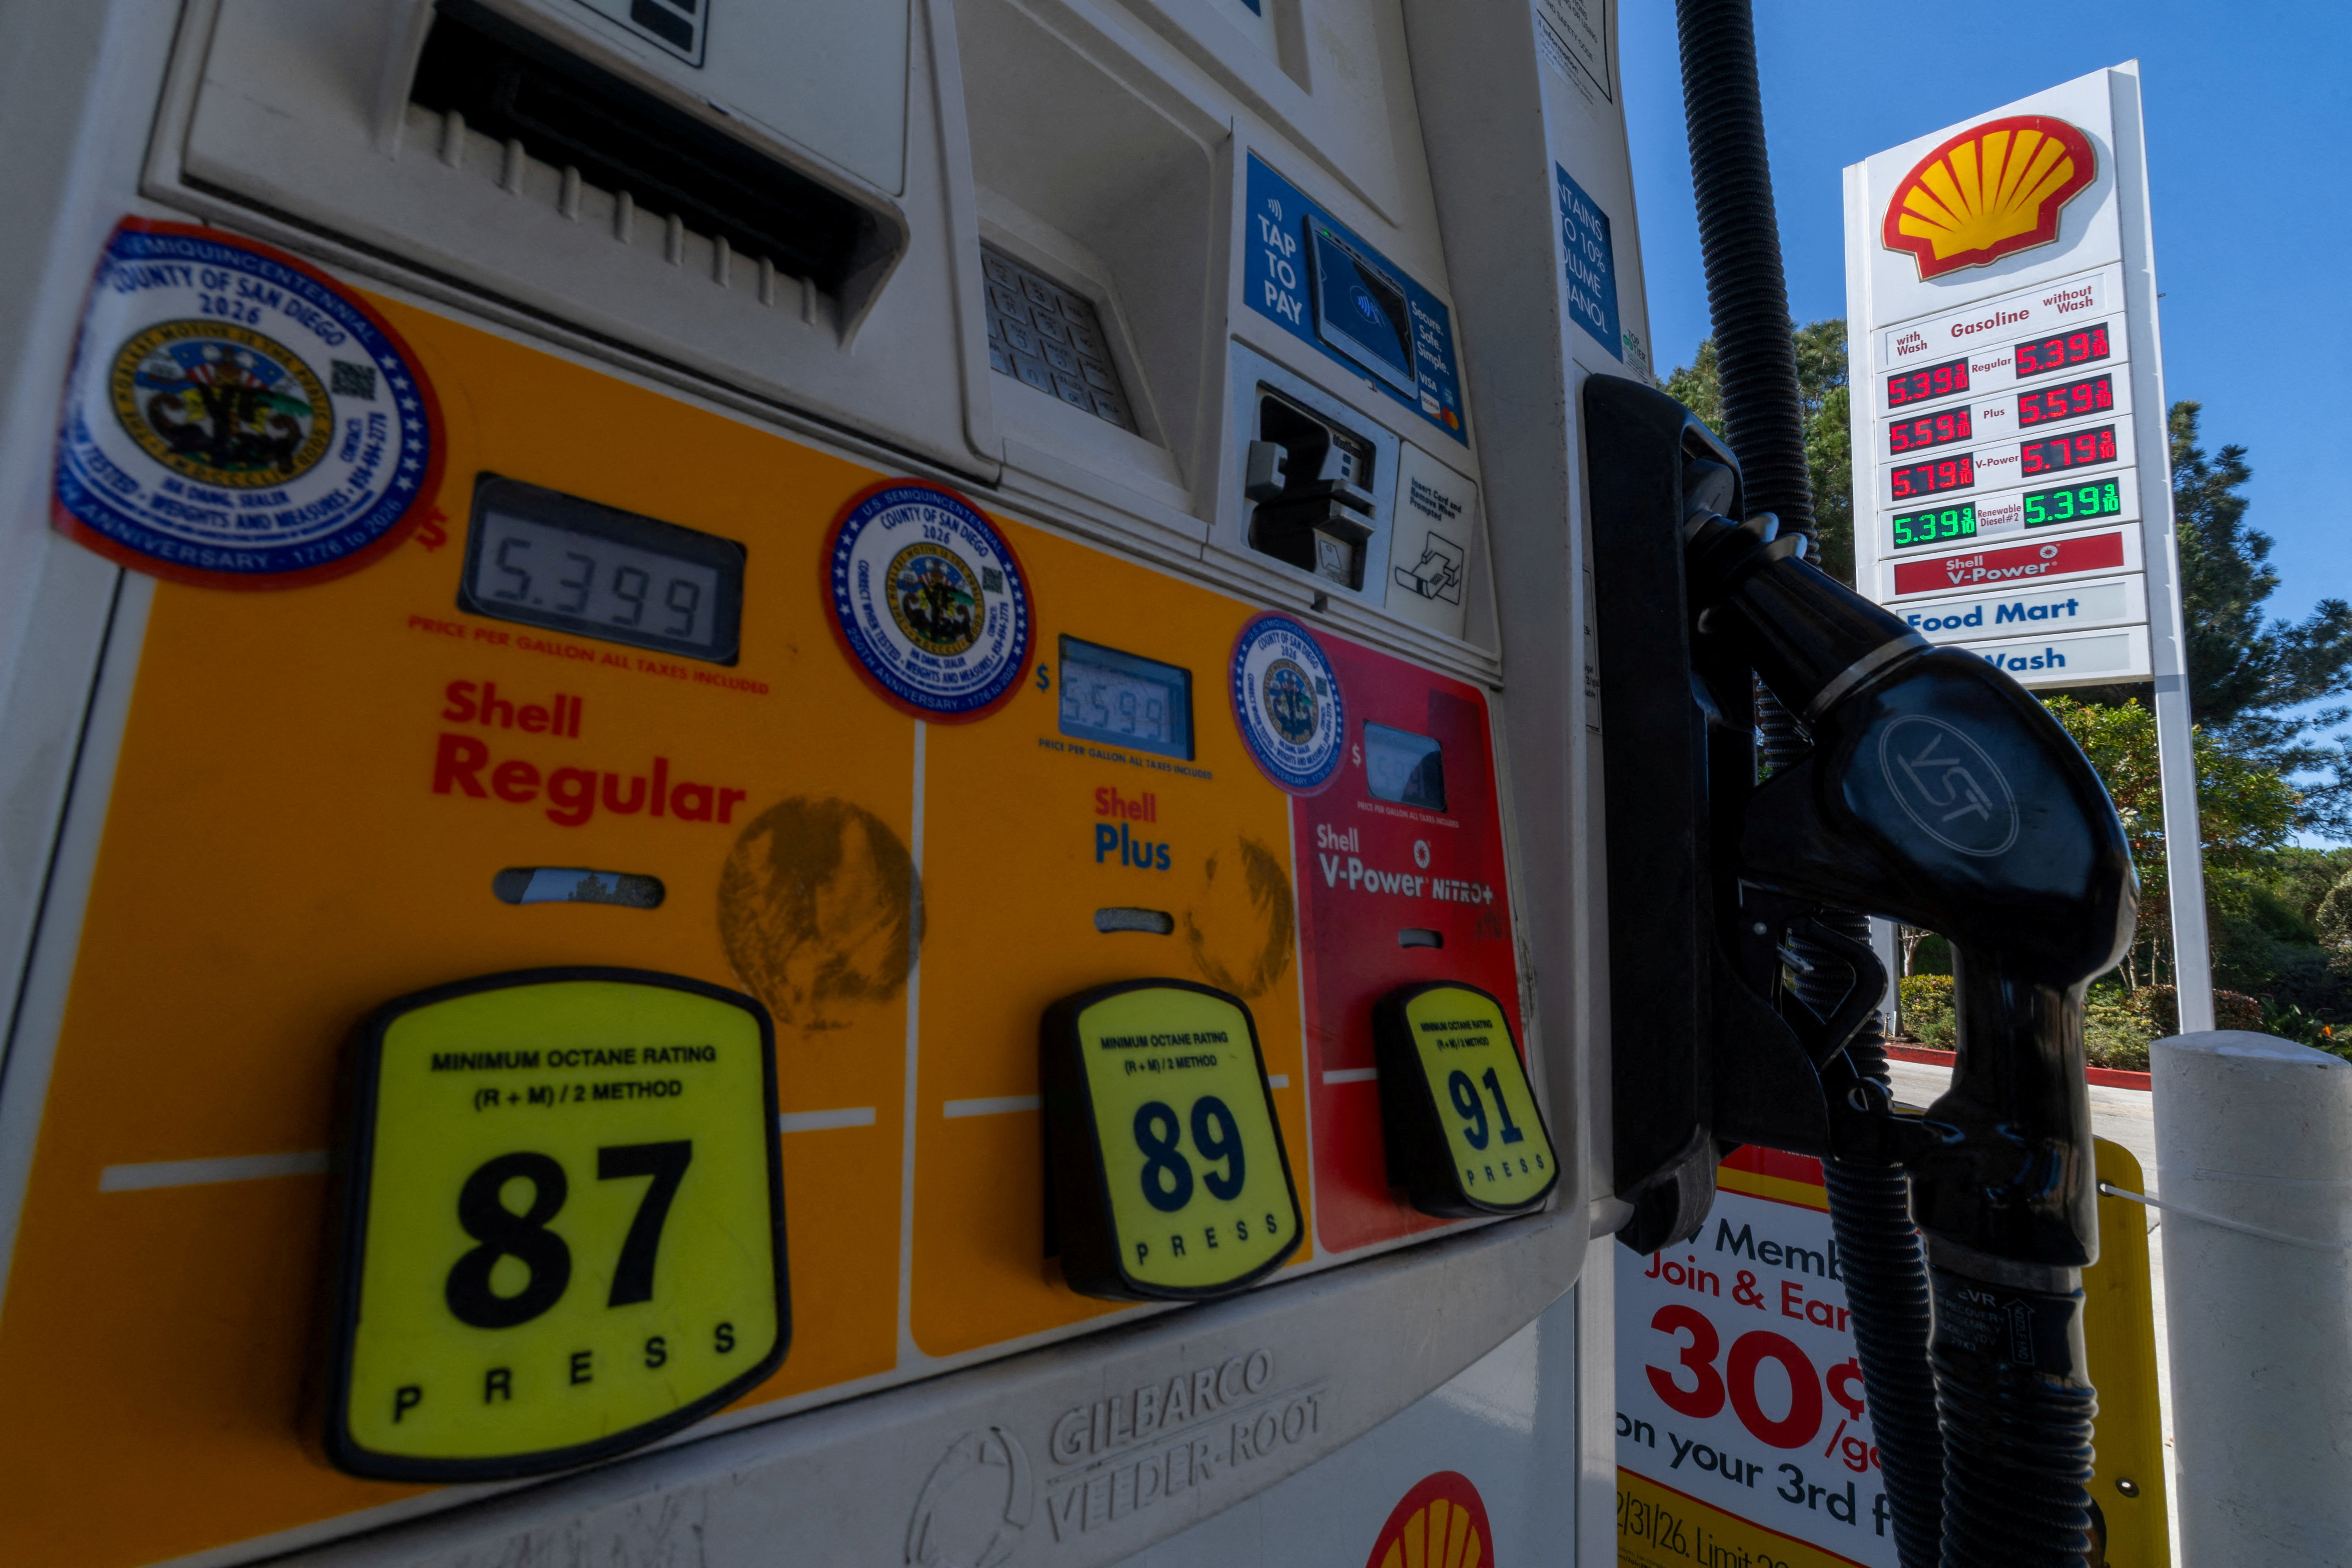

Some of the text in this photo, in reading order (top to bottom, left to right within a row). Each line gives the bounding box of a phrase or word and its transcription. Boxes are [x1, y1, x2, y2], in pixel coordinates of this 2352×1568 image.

[1258, 214, 1296, 259] TAP
[1581, 232, 1605, 273] 10%
[1265, 250, 1296, 289] TO
[198, 292, 262, 325] 2026
[200, 268, 231, 292] OF
[236, 276, 284, 310] SAN
[284, 299, 347, 346] DIEGO
[1265, 281, 1302, 325] PAY
[2043, 286, 2093, 306] without
[2057, 296, 2093, 313] Wash
[1412, 301, 1443, 336] Secure.
[1951, 310, 2030, 337] Gasoline
[1419, 324, 1442, 352] Safe.
[1627, 329, 1639, 346] TOP
[1633, 344, 1646, 363] TIER
[1897, 331, 1920, 346] with
[1897, 340, 1927, 356] Wash
[1417, 341, 1449, 375] Simple.
[1972, 358, 2012, 373] Regular
[1418, 371, 1437, 392] VISA
[1983, 408, 2005, 419] Plus
[1975, 455, 2019, 469] V-Power
[235, 513, 272, 530] AND
[275, 488, 351, 527] MEASURES
[1410, 496, 1441, 521] Prompted
[1411, 486, 1455, 519] Remove When
[1412, 476, 1461, 513] Insert Card and
[1978, 504, 2021, 518] Renewable
[81, 498, 403, 569] ANNIVERSARY 1776 to 2026
[880, 507, 989, 557] COUNTY OF SAN DIEGO
[884, 490, 1003, 553] SEMIQUINCENTENNIAL
[923, 525, 950, 545] 2026
[416, 506, 700, 637] $ 5.399
[1946, 556, 1983, 570] Shell
[1947, 562, 2050, 585] V-Power
[858, 560, 871, 600] CORRECT
[874, 629, 901, 662] TESTED
[905, 659, 940, 682] WEIGHTS
[943, 672, 959, 684] AND
[959, 655, 993, 682] MEASURES
[1907, 598, 2078, 631] Food Mart
[408, 615, 770, 696] PRICE PER GALLON ALL TAXES INCLUDED
[1258, 632, 1318, 669] COUNTY OF SAN DIEGO
[1260, 620, 1326, 666] SEMIQUINCENTENNIAL
[1281, 646, 1297, 660] 2026
[847, 628, 1017, 709] 250TH ANNIVERSARY 1776 to 2026
[1036, 663, 1050, 693] $
[442, 679, 582, 739] Shell
[1039, 739, 1212, 780] PRICE PER GALLON ALL TAXES INCLUDED
[1261, 754, 1307, 785] ANNIVERSARY
[1297, 756, 1307, 766] AND
[1353, 743, 1361, 767] $
[431, 732, 746, 828] Regular
[1094, 787, 1156, 823] Shell
[1357, 801, 1458, 828] PRICE PER GALLON ALL TAXES INCLUDED
[1095, 823, 1171, 871] Plus
[1316, 824, 1359, 852] Shell
[1319, 853, 1424, 897] V-Power
[1101, 1031, 1228, 1050] MINIMUM OCTANE RATING
[1420, 1019, 1493, 1032] MINIMUM OCTANE RATING
[1465, 1036, 1489, 1047] METHOD
[432, 1045, 716, 1071] MINIMUM OCTANE RATING
[1176, 1055, 1217, 1069] METHOD
[592, 1081, 683, 1101] METHOD
[1447, 1066, 1523, 1151] 91
[1133, 1095, 1246, 1212] 89
[445, 1140, 693, 1329] 87
[1644, 1251, 1720, 1298] Join
[1732, 1269, 1767, 1311] &
[1049, 1345, 1275, 1466] GILBARCO
[1046, 1388, 1327, 1543] VEEDER-ROOT
[1615, 1412, 1656, 1448] on
[1668, 1432, 1763, 1490] your
[1777, 1464, 1856, 1526] 3rd
